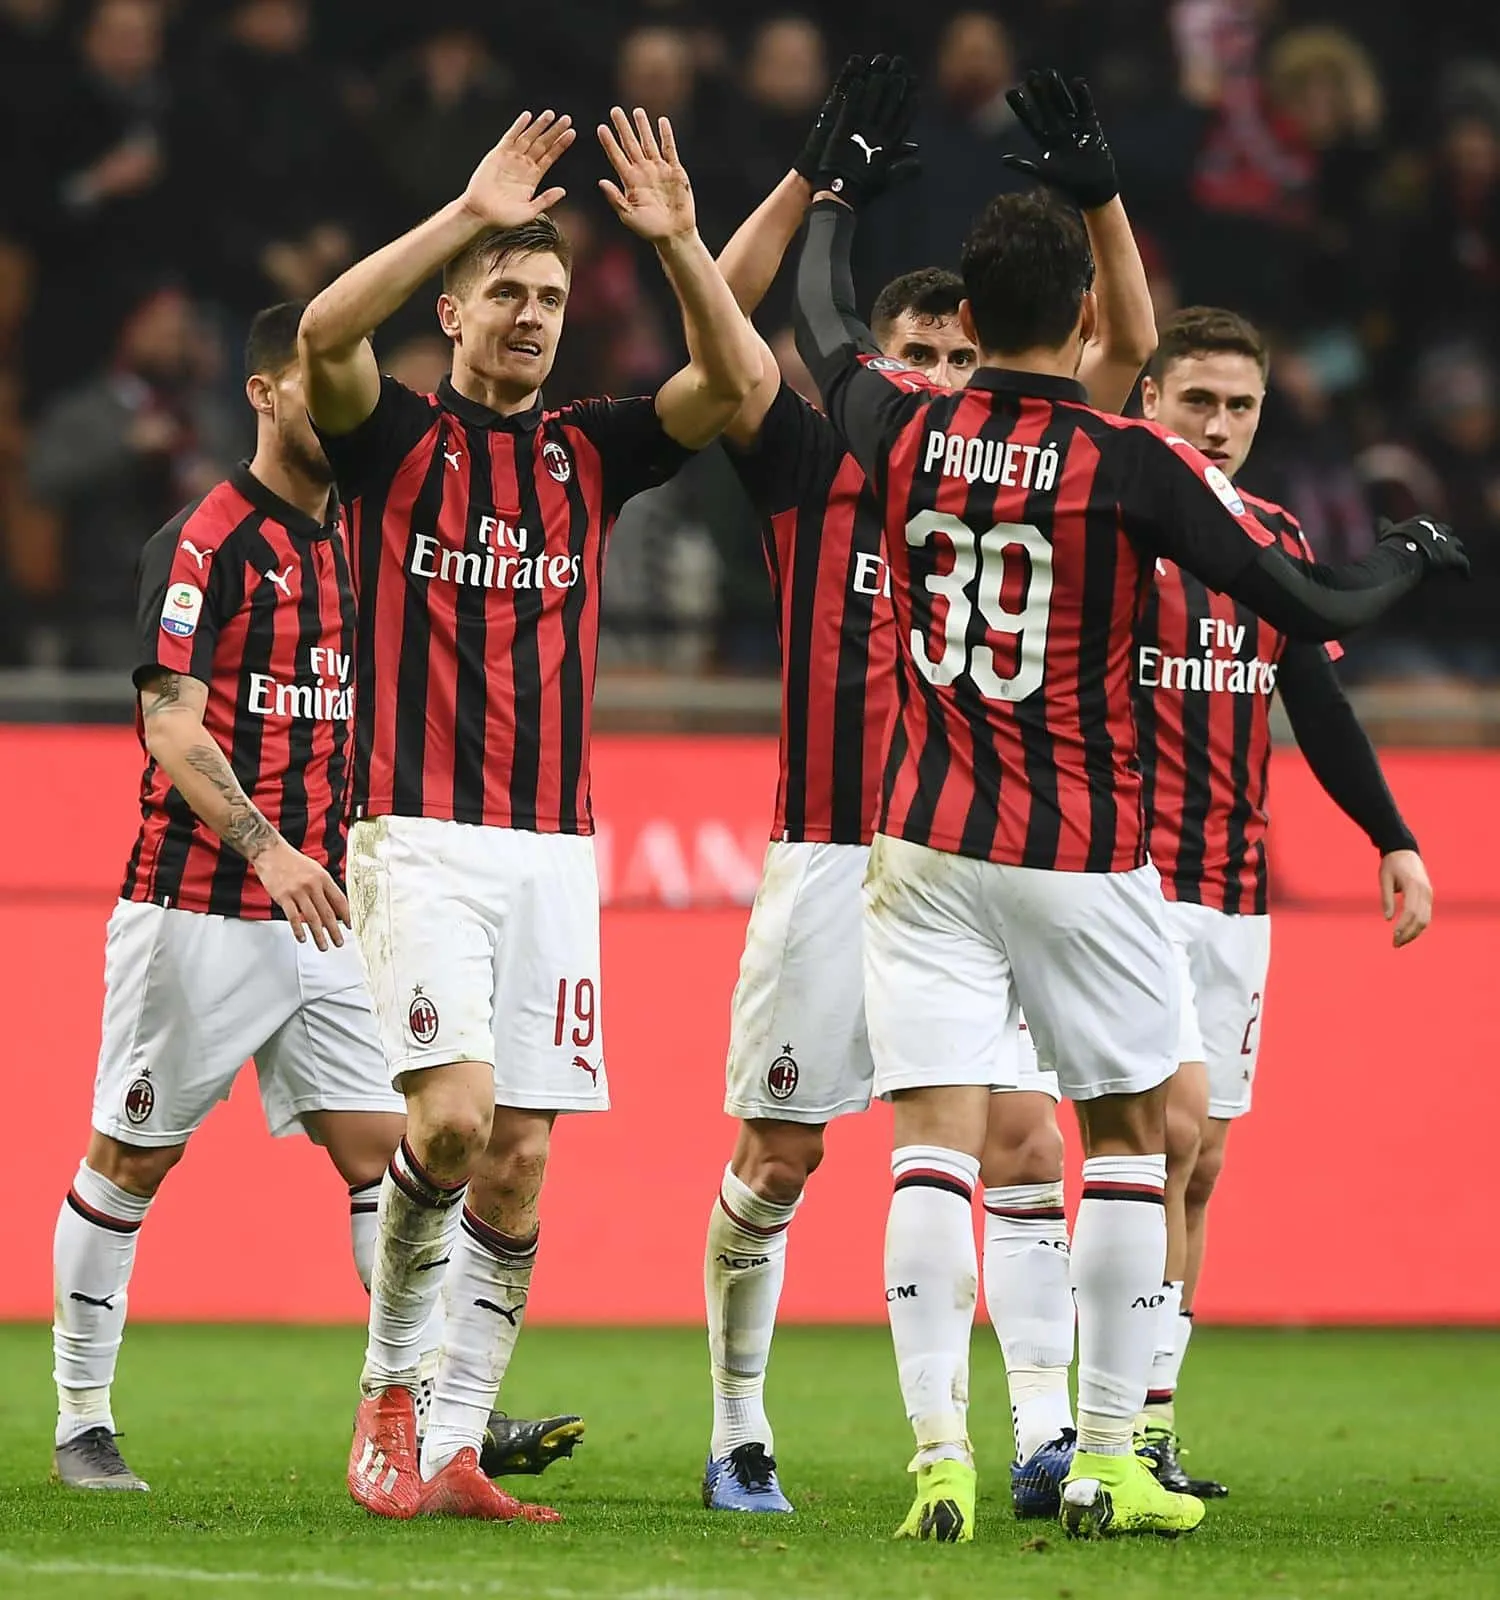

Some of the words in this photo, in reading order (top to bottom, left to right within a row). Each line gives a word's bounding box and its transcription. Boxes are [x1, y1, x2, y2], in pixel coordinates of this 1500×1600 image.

[924, 430, 1059, 490] PAQUETÁ
[479, 515, 527, 552] Fly
[411, 533, 580, 589] Emirates
[854, 552, 891, 598] E
[905, 509, 1053, 702] 39
[1200, 618, 1246, 654] Fly
[310, 647, 350, 683] Fly
[1139, 646, 1278, 695] Emirates
[554, 978, 594, 1047] 19
